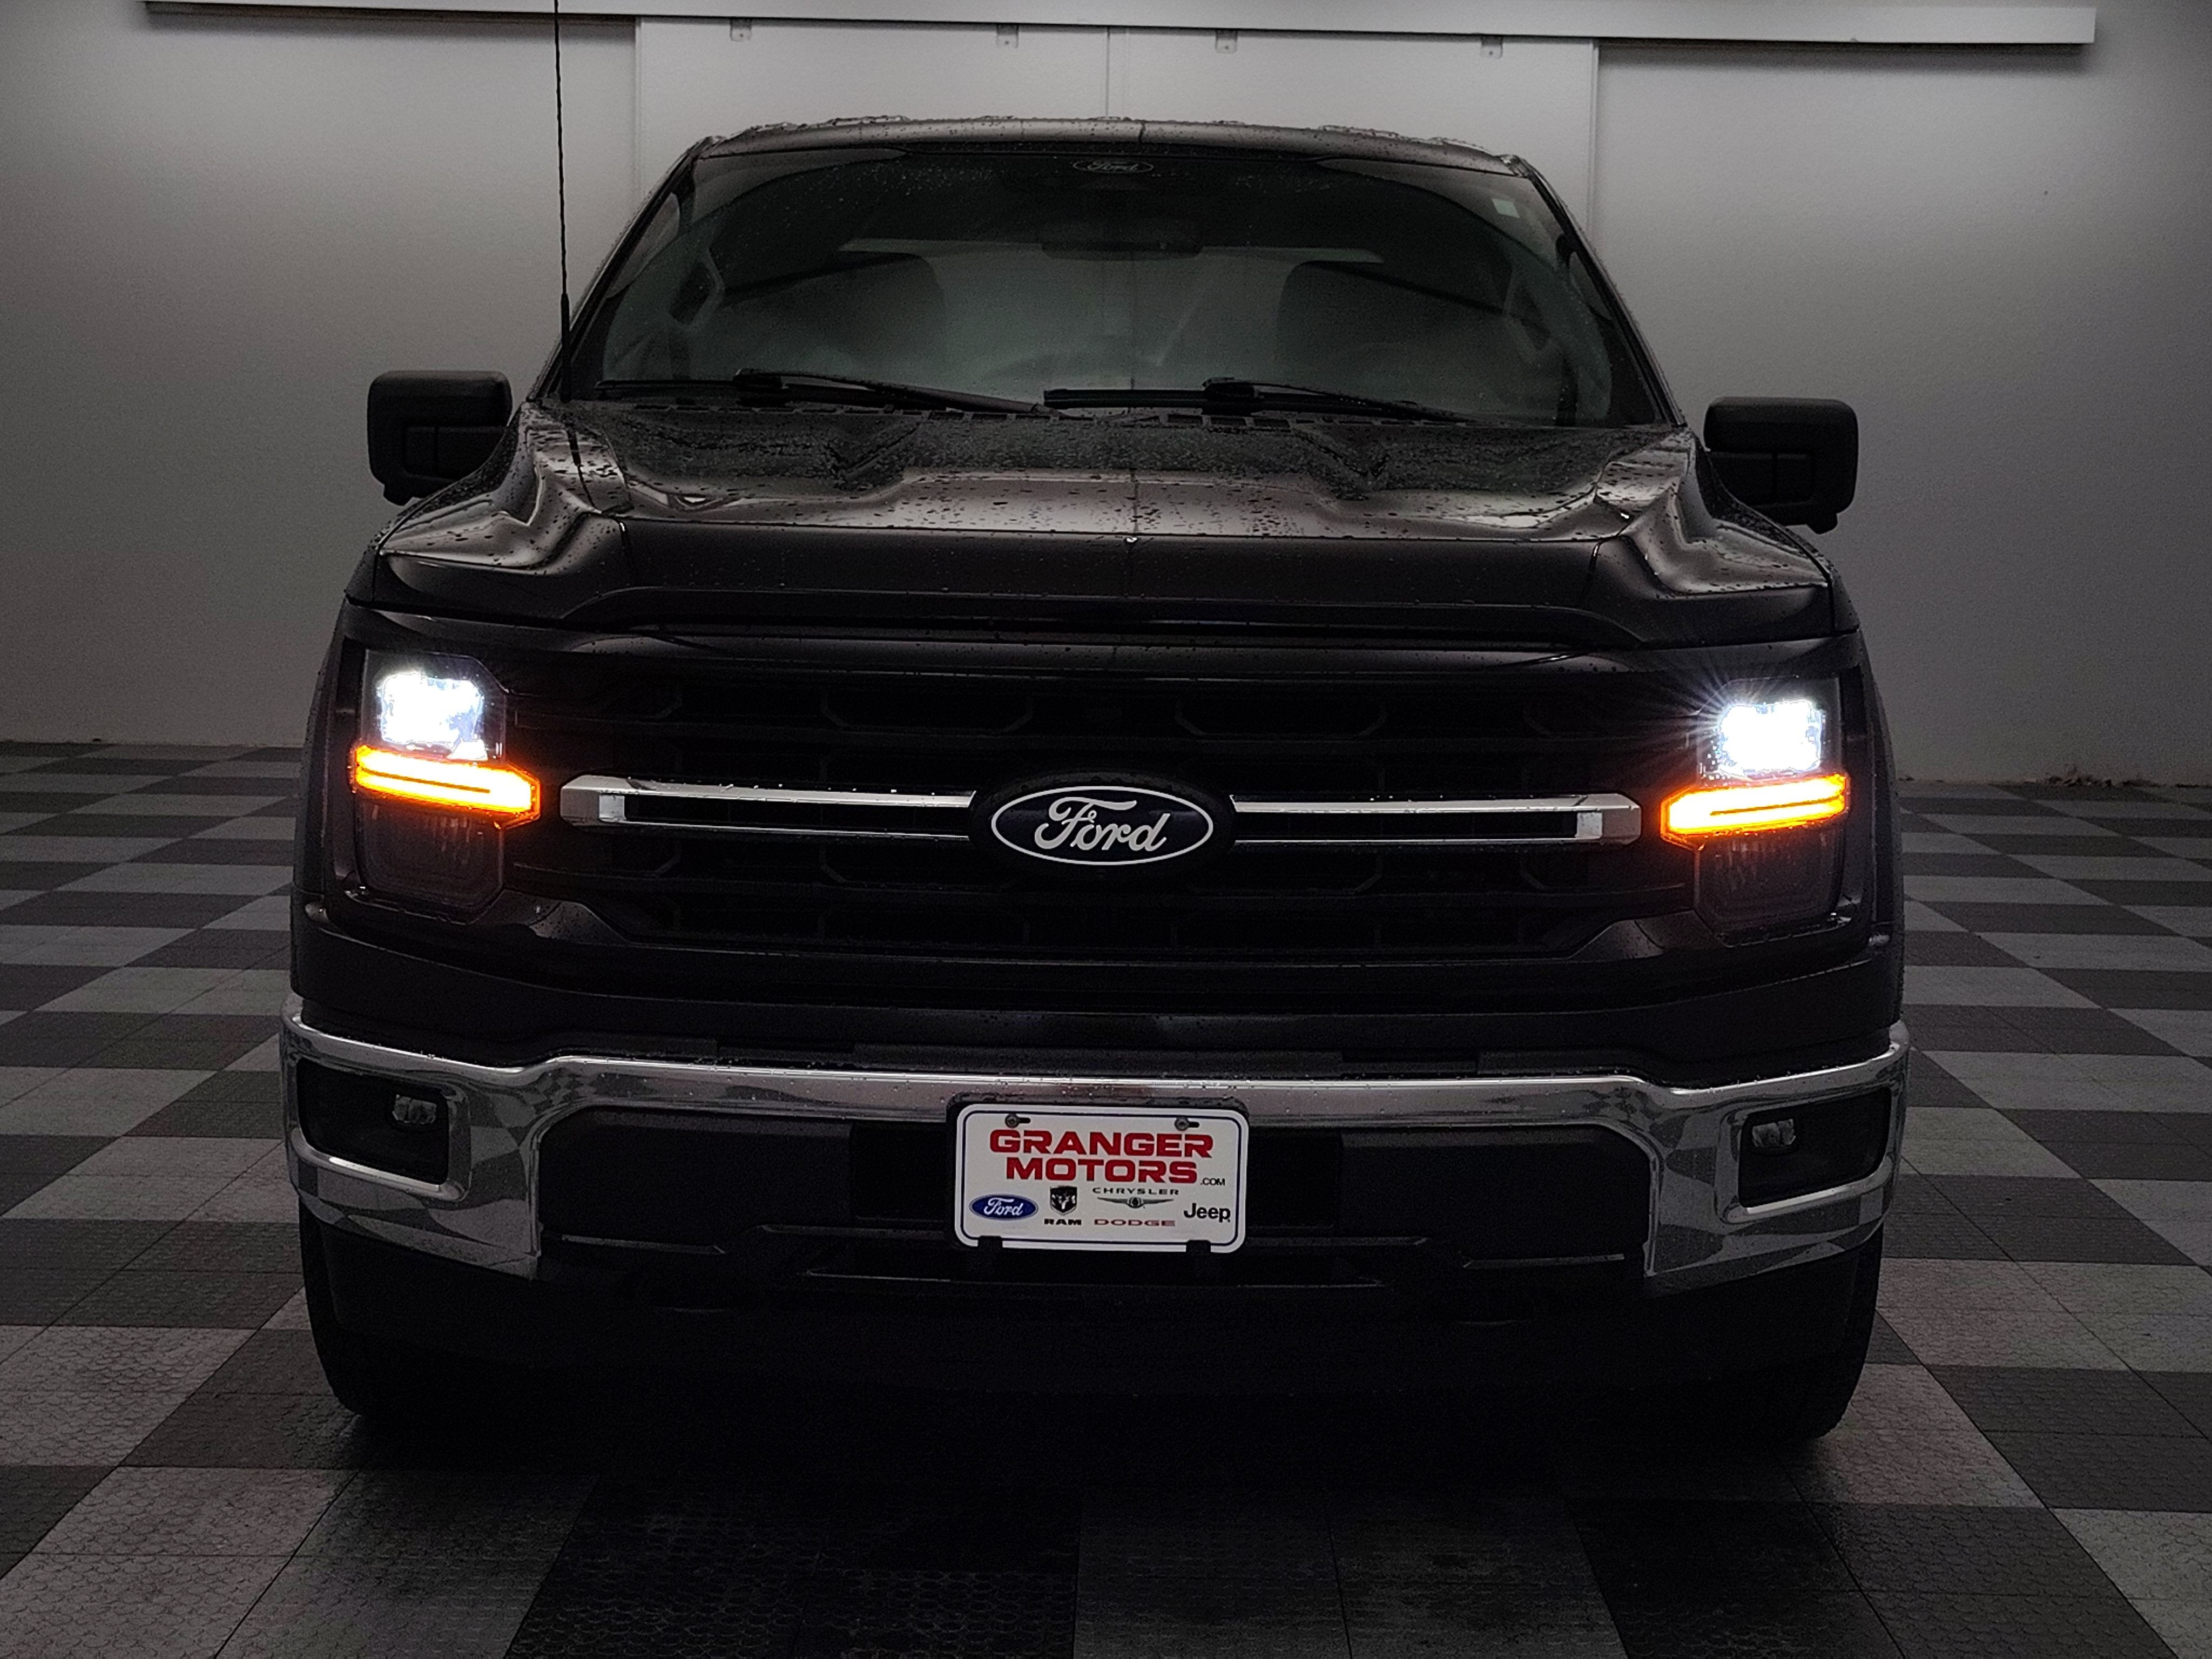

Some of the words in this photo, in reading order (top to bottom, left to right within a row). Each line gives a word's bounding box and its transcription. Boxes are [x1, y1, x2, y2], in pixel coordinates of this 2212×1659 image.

[1034, 797, 1171, 852] Ford
[989, 1129, 1213, 1158] GRANGER
[1006, 1157, 1197, 1184] MOTORS
[1200, 1177, 1225, 1186] .COM
[1092, 1187, 1179, 1196] CHRYSLER
[983, 1198, 1023, 1217] Ford
[1184, 1203, 1231, 1223] Jeep
[1094, 1218, 1176, 1227] DODGE
